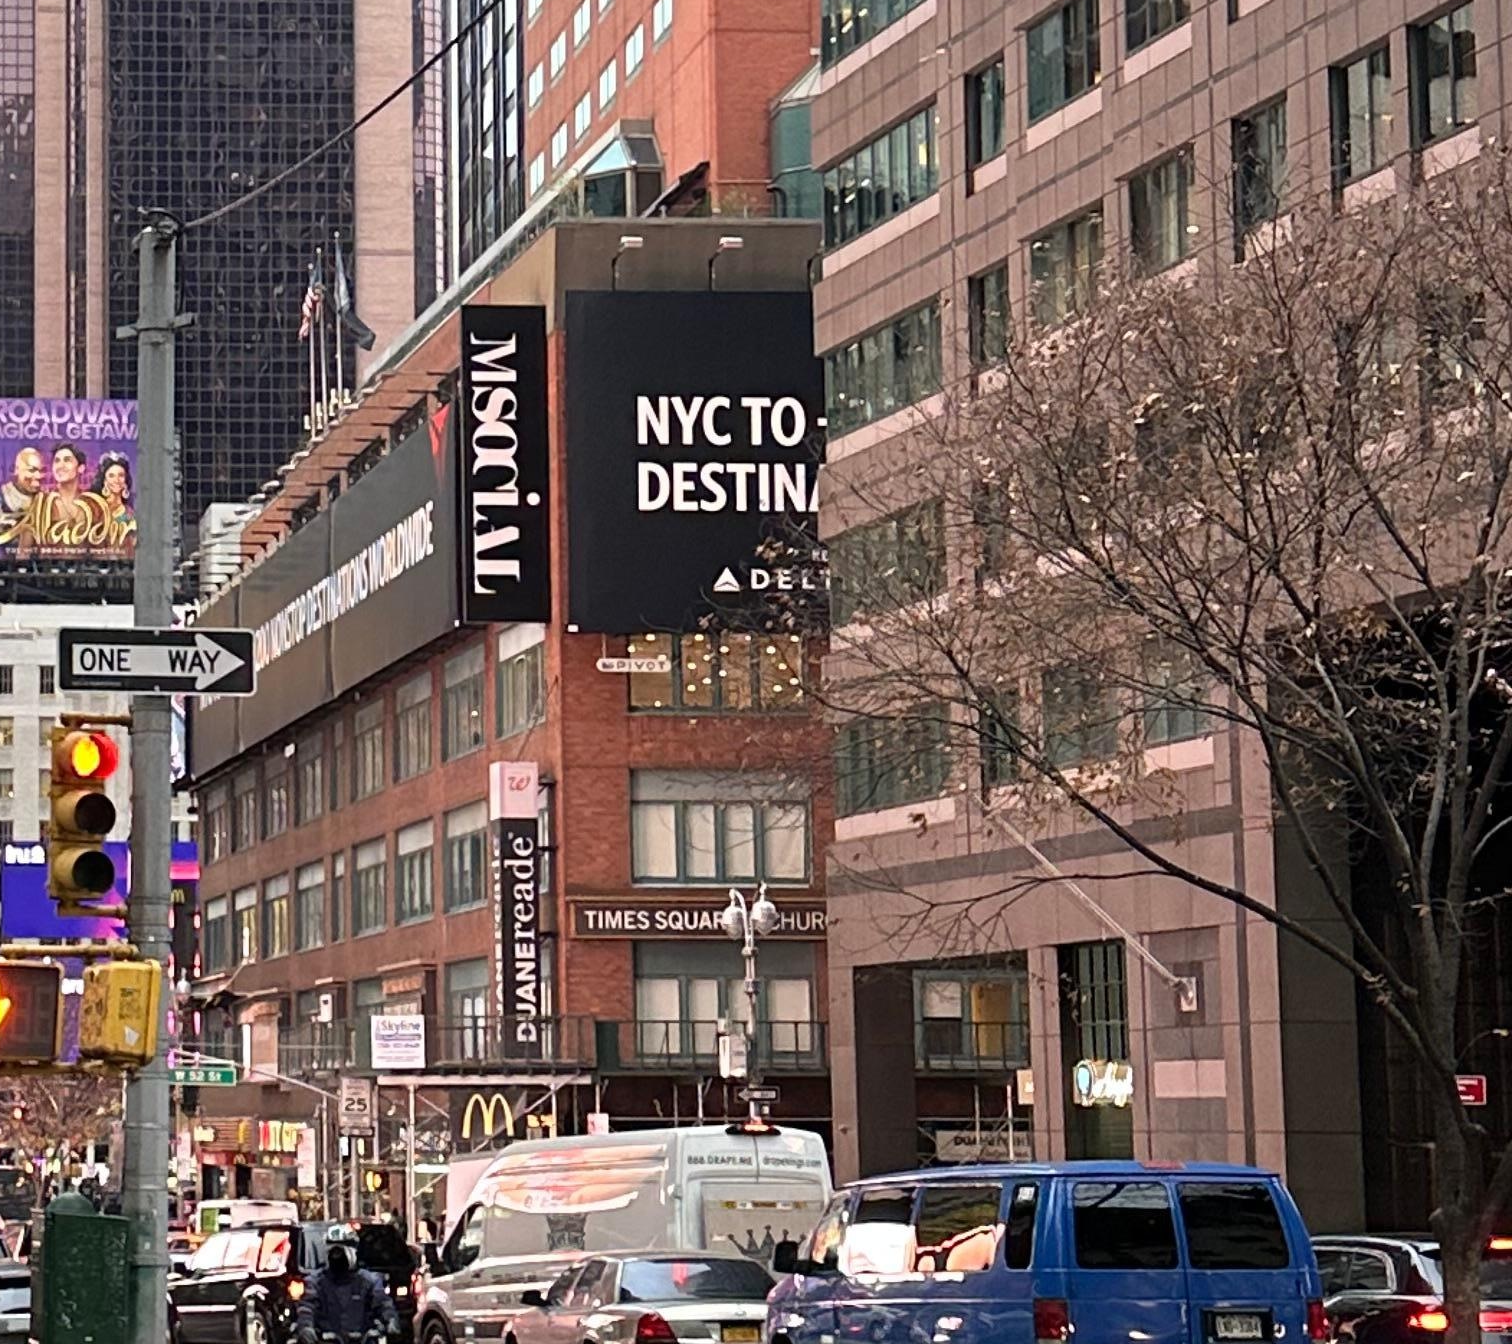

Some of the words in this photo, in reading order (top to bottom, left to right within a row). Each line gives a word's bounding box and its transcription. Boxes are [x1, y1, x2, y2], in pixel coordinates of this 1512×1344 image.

[637, 396, 731, 446] NYC
[741, 397, 806, 446] TO
[369, 500, 433, 594] WORLDWIDE
[80, 647, 131, 672] ONE
[168, 649, 221, 674] WAY
[585, 910, 649, 930] TIMES
[655, 910, 724, 932] SQUAR
[175, 1071, 186, 1081] W
[345, 1097, 367, 1112] 25
